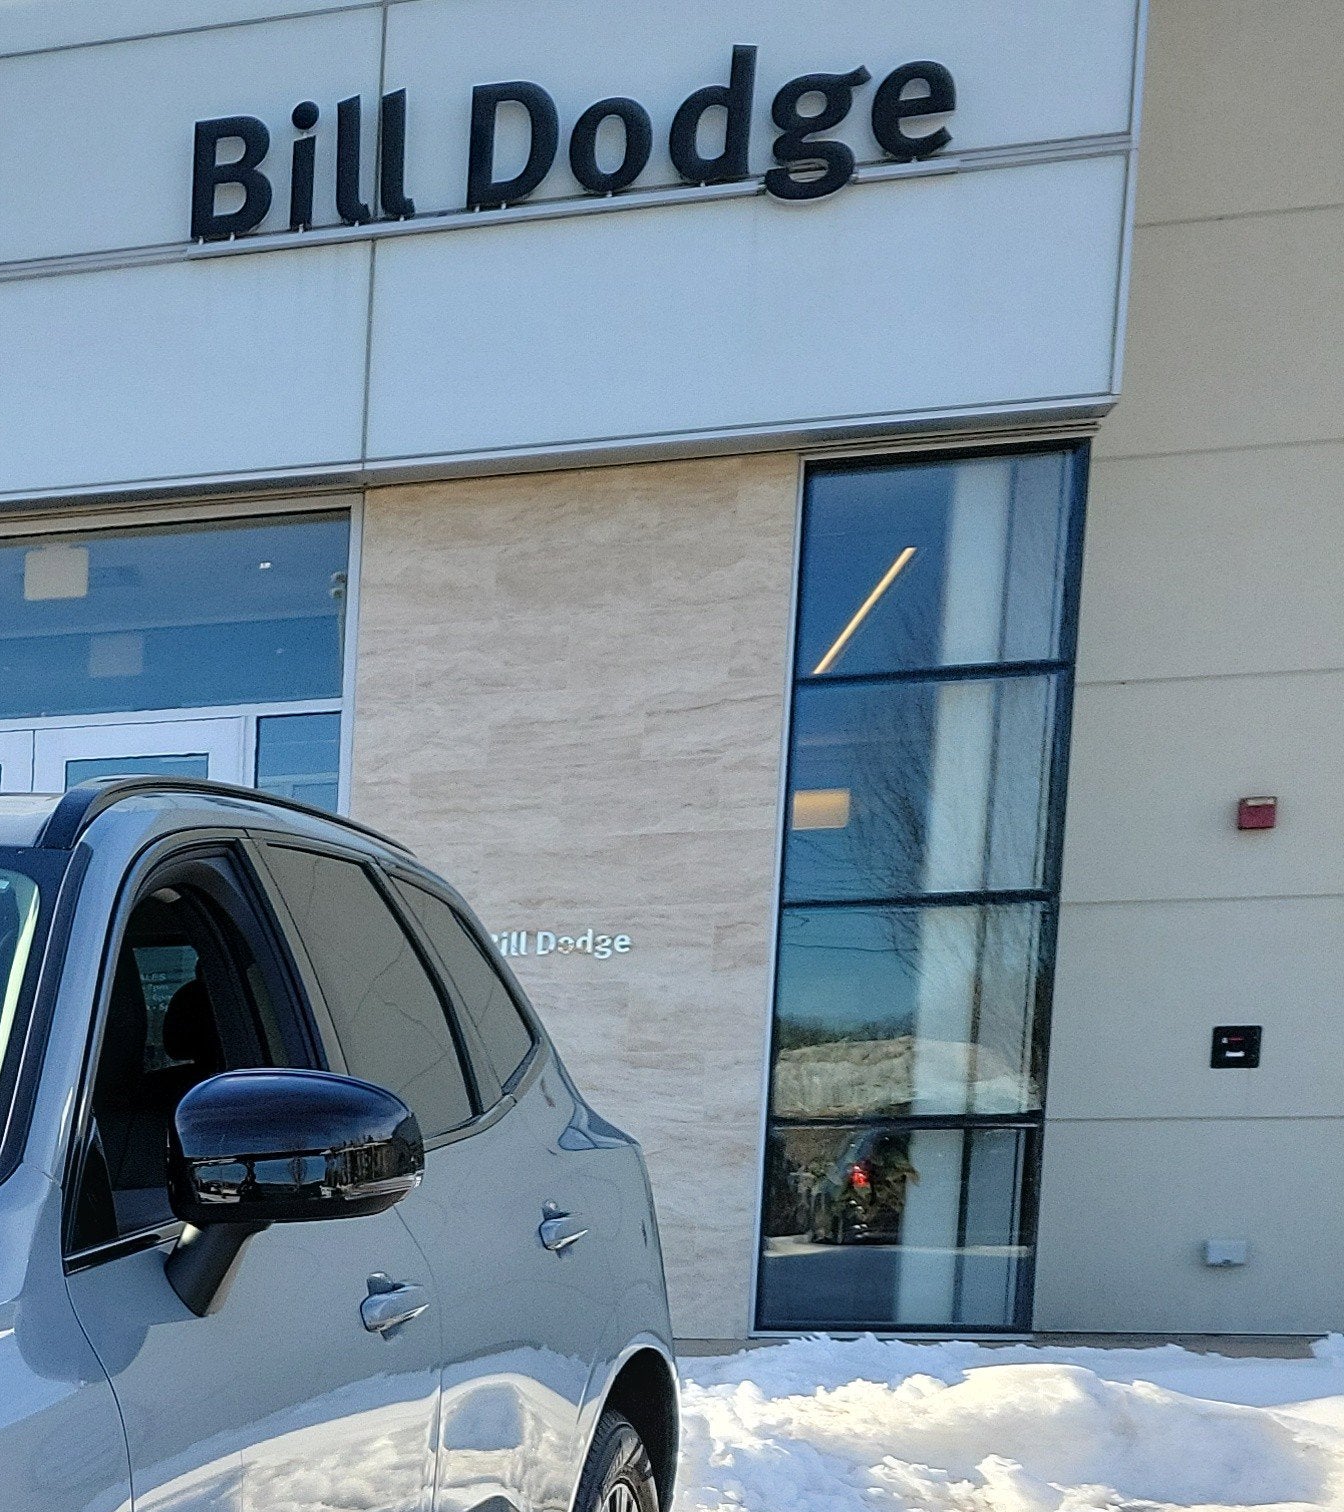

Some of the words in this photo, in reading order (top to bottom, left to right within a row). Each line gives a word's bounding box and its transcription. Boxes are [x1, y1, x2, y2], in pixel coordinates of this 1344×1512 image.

[190, 87, 416, 242] Bill
[466, 43, 958, 202] Dodge
[537, 928, 633, 960] Dodge
